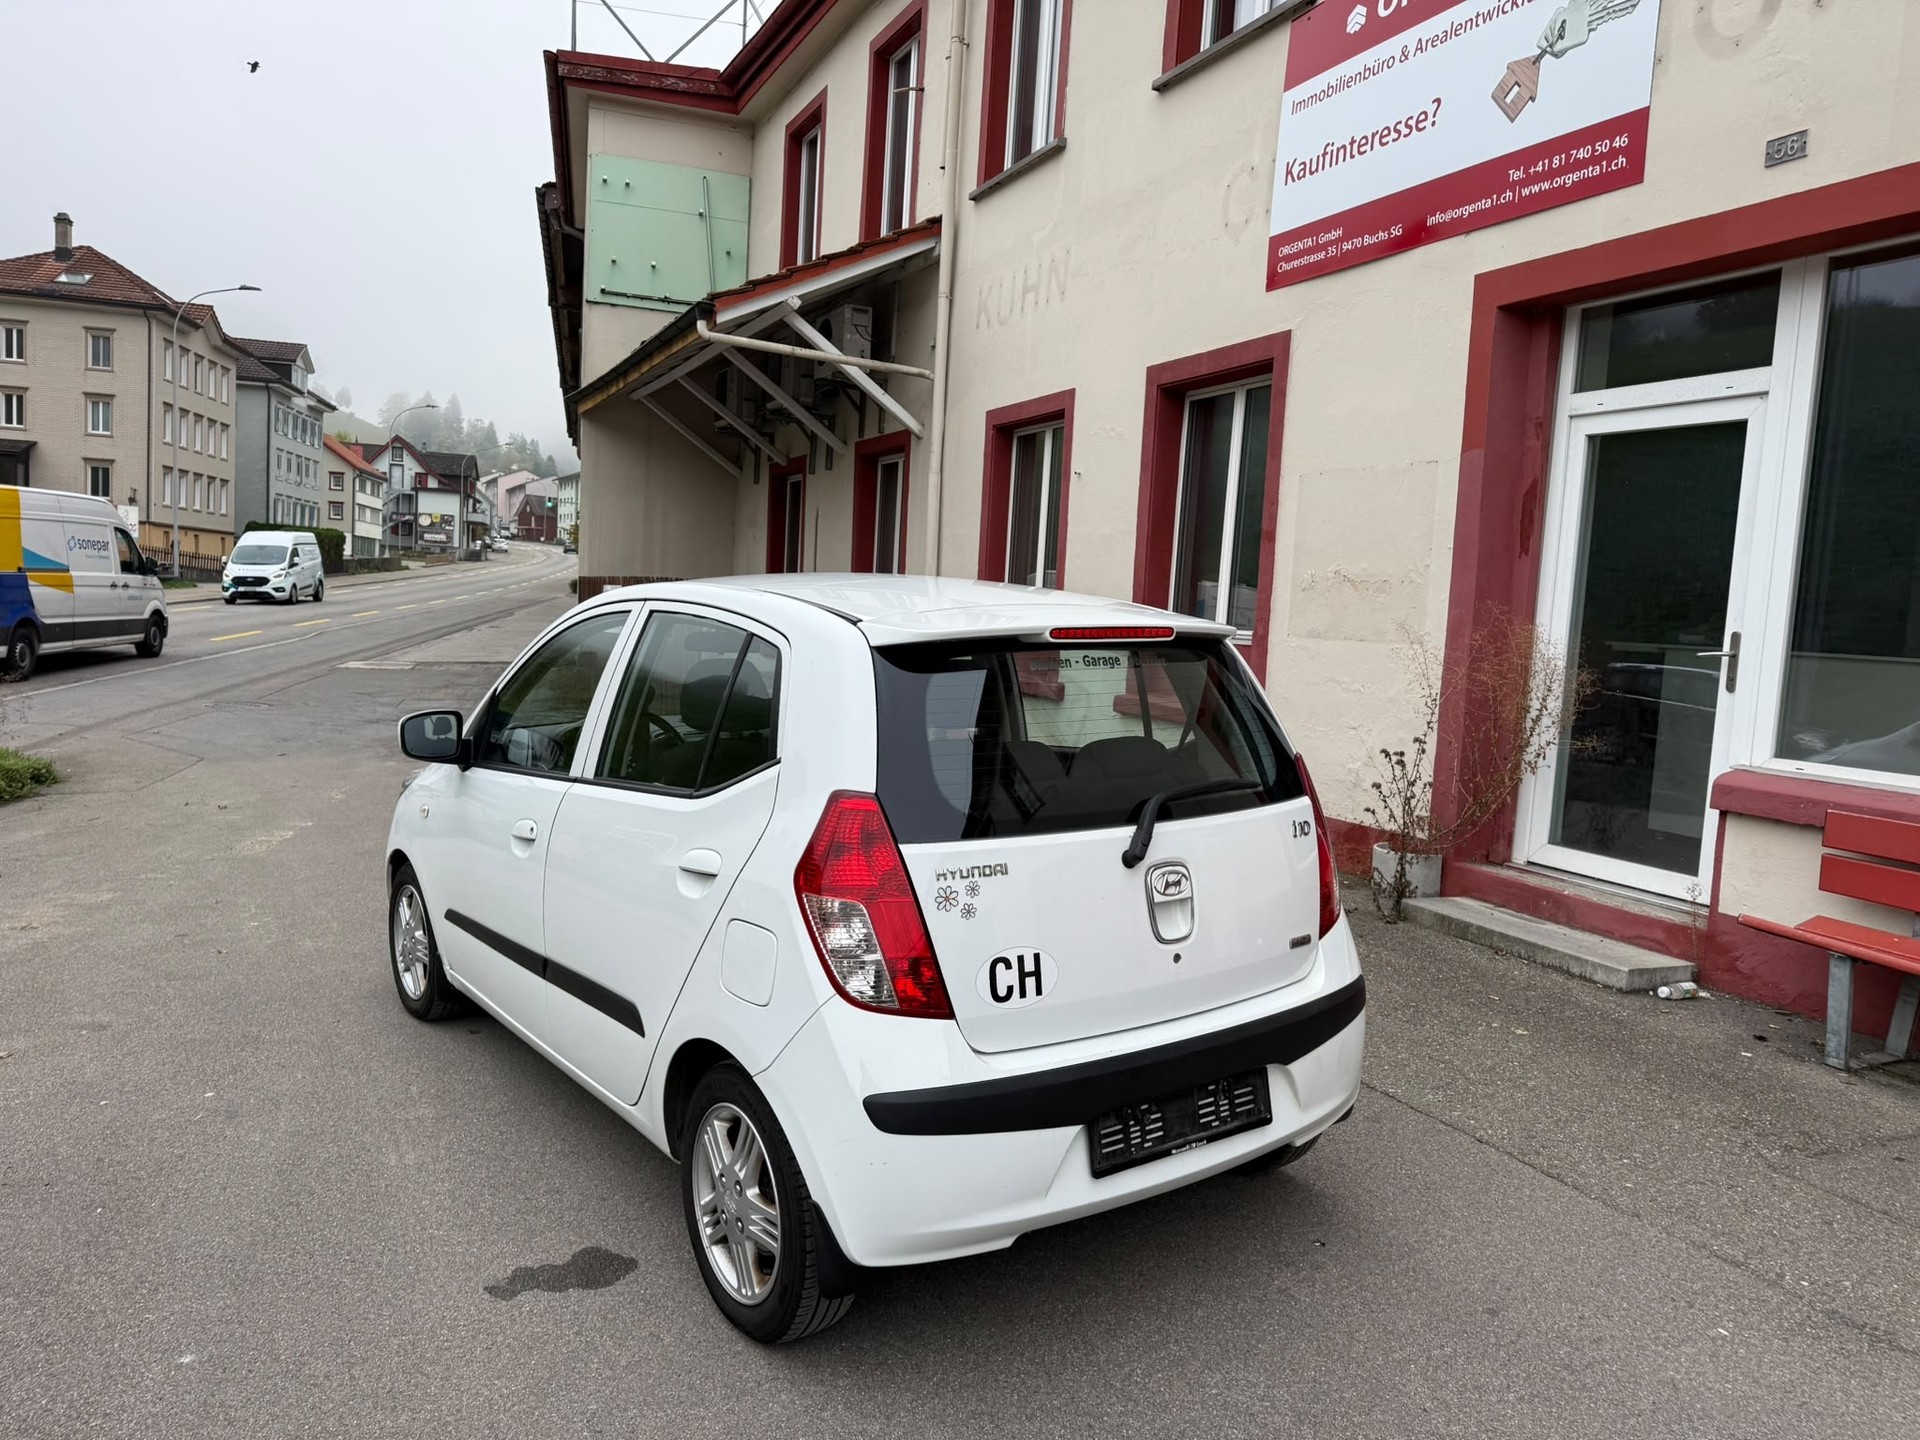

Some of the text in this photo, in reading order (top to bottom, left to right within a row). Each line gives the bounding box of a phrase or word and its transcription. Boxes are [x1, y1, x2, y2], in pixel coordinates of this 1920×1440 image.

[1291, 55, 1395, 116] Immobilienbüro
[1398, 44, 1410, 63] &
[1284, 97, 1442, 187] Kaufinteresse?
[1507, 133, 1629, 183] Tel. +41 81 740 50 46
[1774, 136, 1799, 160] 56
[1426, 188, 1513, 227] info@orgenta1.ch
[1521, 154, 1627, 197] www.orgenta1.ch
[1277, 250, 1326, 273] Churerstrasse
[1327, 245, 1337, 258] 35
[1342, 237, 1362, 253] 9470
[1363, 230, 1389, 246] Buchs
[1390, 224, 1403, 237] SG
[1278, 227, 1343, 258] ORGENTA1 GmbH
[77, 538, 110, 553] sonepar
[1082, 654, 1121, 669] Garage
[935, 862, 1009, 881] HYUNDAI
[989, 952, 1043, 1004] CH
